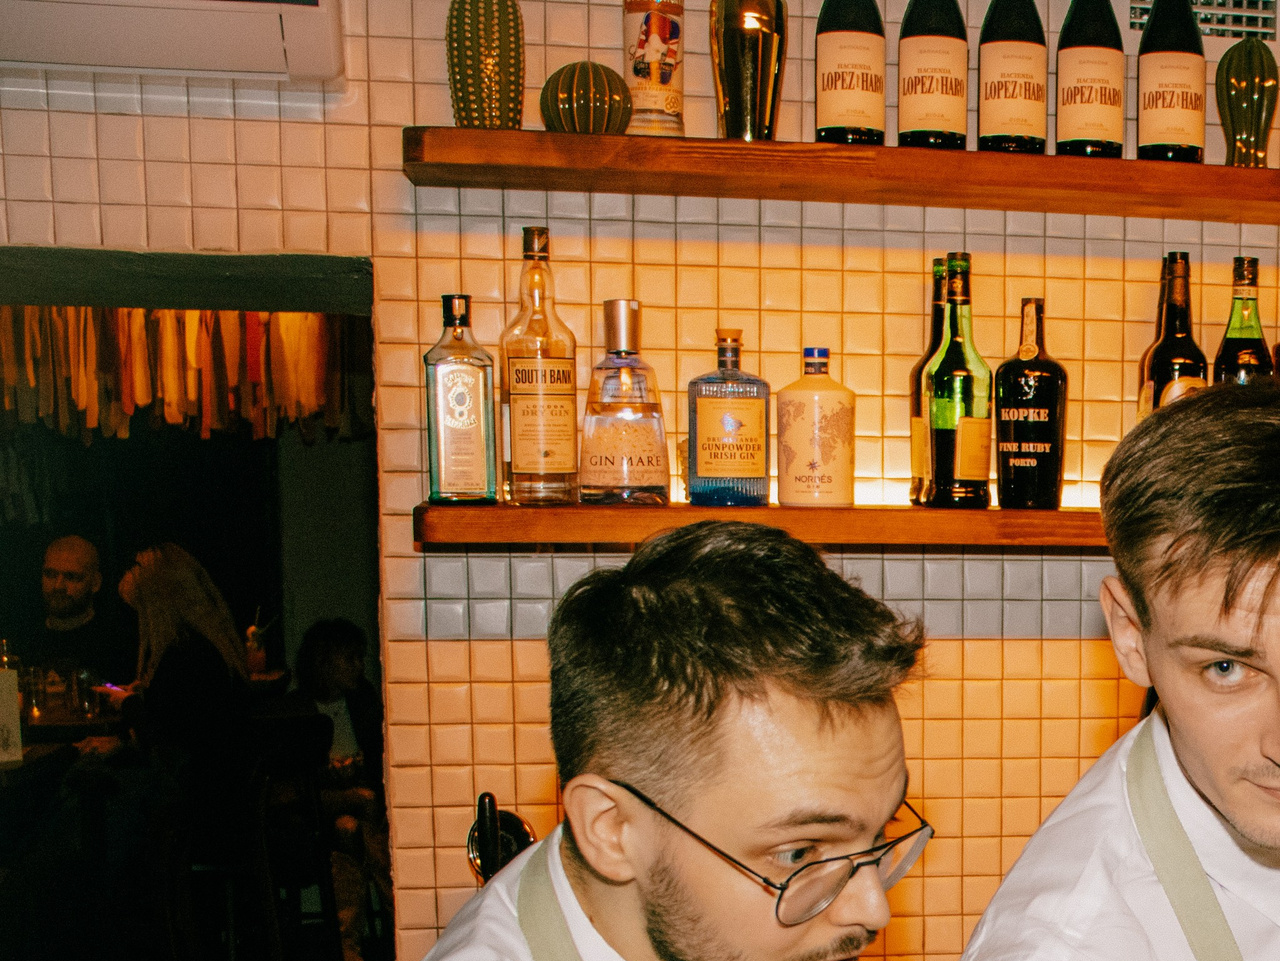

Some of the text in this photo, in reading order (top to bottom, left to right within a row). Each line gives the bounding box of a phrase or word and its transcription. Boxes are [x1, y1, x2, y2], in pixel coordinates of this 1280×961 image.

[837, 63, 871, 71] HACIENDA
[917, 67, 951, 75] HACIENDA
[1000, 72, 1034, 80] HACIENDA
[822, 72, 884, 94] LOPEZ HARO
[902, 75, 965, 98] LOPEZ HARO
[1158, 82, 1192, 90] HACIENDA
[984, 80, 1045, 104] LOPEZ HARO
[1062, 85, 1122, 108] LOPEZ HARO
[1143, 90, 1203, 112] LOPEZ HARO
[515, 369, 572, 384] SOUTH BANK
[550, 409, 570, 417] GIN
[1001, 408, 1049, 422] KOPKE
[702, 443, 762, 451] GUNPOWDER
[1021, 442, 1052, 453] RUBY
[590, 455, 662, 467] GIN MARE
[709, 452, 756, 460] IRISH GIN
[1009, 458, 1037, 467] PORTO
[794, 474, 833, 484] NORDÉS
